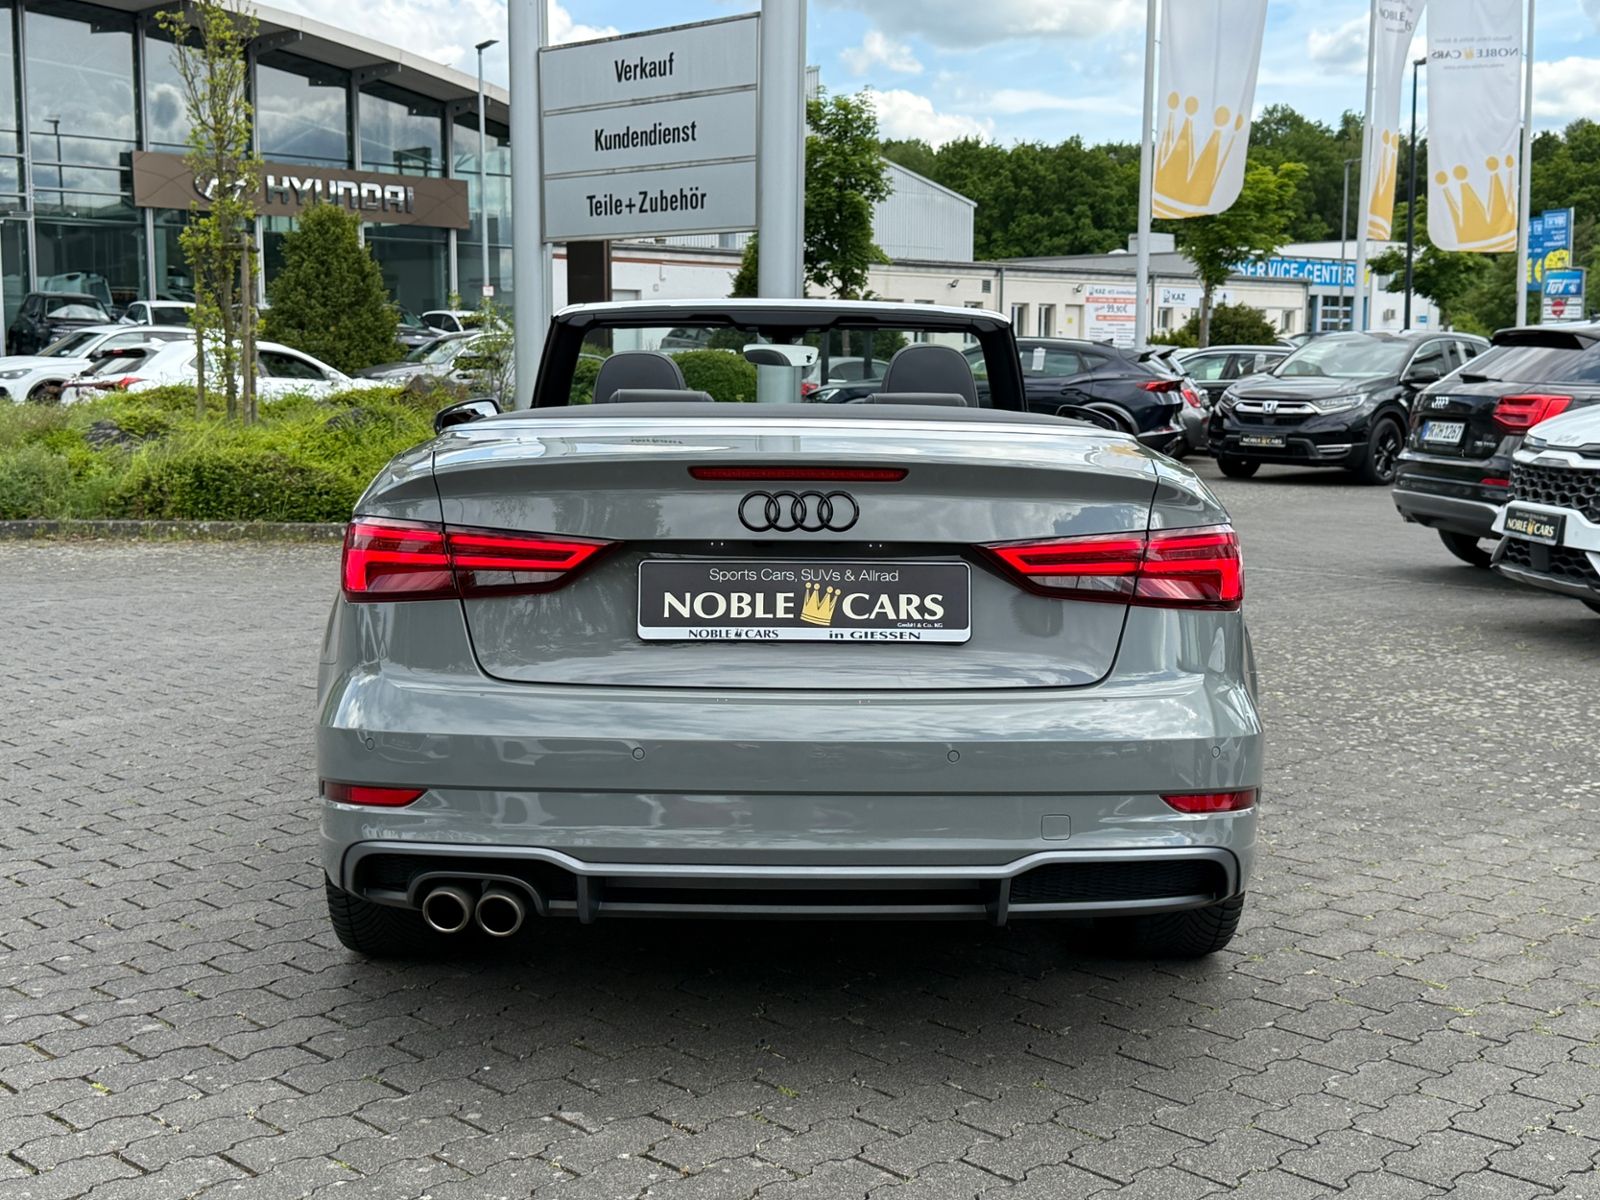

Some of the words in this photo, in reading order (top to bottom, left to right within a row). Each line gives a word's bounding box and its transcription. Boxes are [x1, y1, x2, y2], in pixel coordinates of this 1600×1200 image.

[614, 52, 675, 83] Verkauf
[594, 120, 697, 152] Kundendienst
[265, 174, 415, 214] HYUNDAI
[586, 186, 707, 217] Teile+Zubehör
[1172, 292, 1186, 301] KAZ
[1545, 279, 1567, 294] TÜV
[1506, 518, 1528, 532] NOBLE
[1534, 523, 1555, 537] CARS
[709, 568, 757, 583] Sports
[760, 568, 798, 583] Cars,
[801, 568, 840, 582] SUVs
[844, 569, 855, 582] &
[859, 569, 899, 582] Allrad
[663, 592, 795, 619] NOBLE
[842, 593, 945, 620] CARS
[688, 628, 732, 639] NOBLE
[744, 628, 779, 639] CARS
[829, 630, 844, 639] in
[850, 630, 921, 640] GIESSEN
